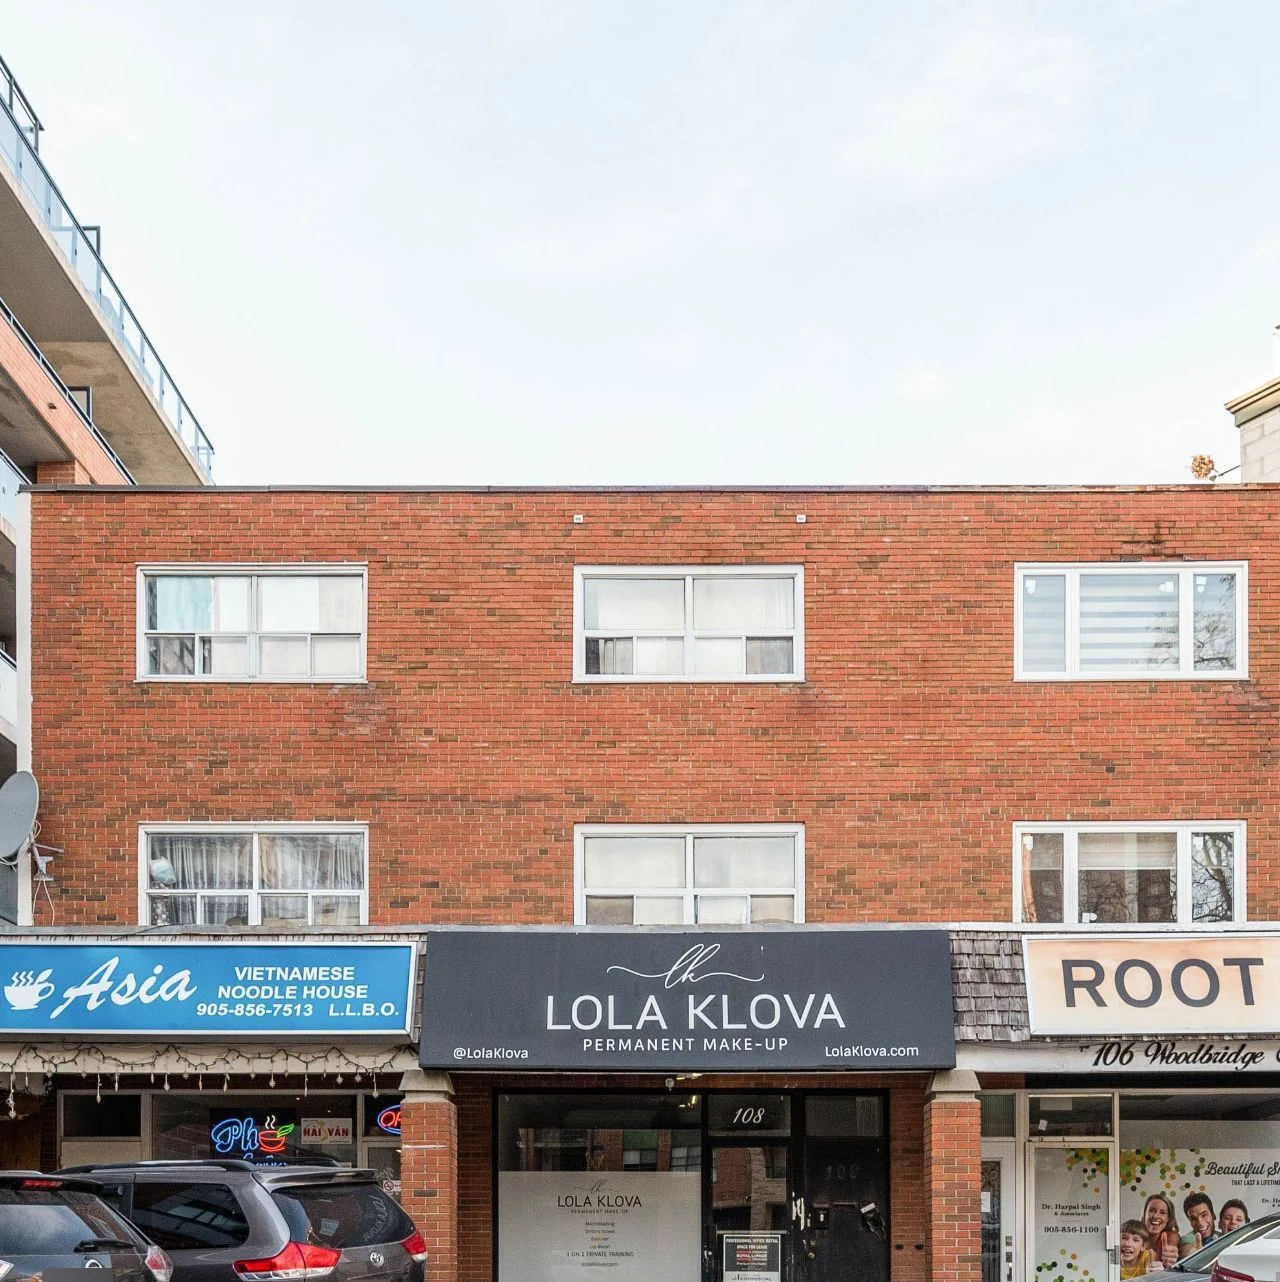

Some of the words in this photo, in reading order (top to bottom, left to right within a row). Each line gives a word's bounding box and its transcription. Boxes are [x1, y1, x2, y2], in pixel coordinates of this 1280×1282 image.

[234, 966, 356, 981] VIETNAMESE
[49, 956, 198, 1019] Asia
[1061, 957, 1264, 1008] ROOT
[217, 985, 298, 999] NOODLE
[302, 984, 369, 999] HOUSE
[196, 1003, 314, 1017] 905-856-7513
[328, 1002, 400, 1017] L.L.B.O.
[546, 994, 668, 1031] LOLA
[688, 993, 846, 1029] KLOVA
[582, 1038, 695, 1052] PERMANENT
[703, 1037, 789, 1051] MAKE-UP
[824, 1045, 920, 1058] LolaKlova.com
[452, 1047, 529, 1060] @LolaKlova
[1092, 1041, 1135, 1066] 106
[1144, 1041, 1266, 1070] Woodbridge
[733, 1107, 765, 1124] 108
[1205, 1161, 1266, 1178] Beautiful
[557, 1195, 593, 1208] LOLA
[597, 1195, 643, 1208] KLOVA
[1044, 1226, 1099, 1234] 905-856-1100
